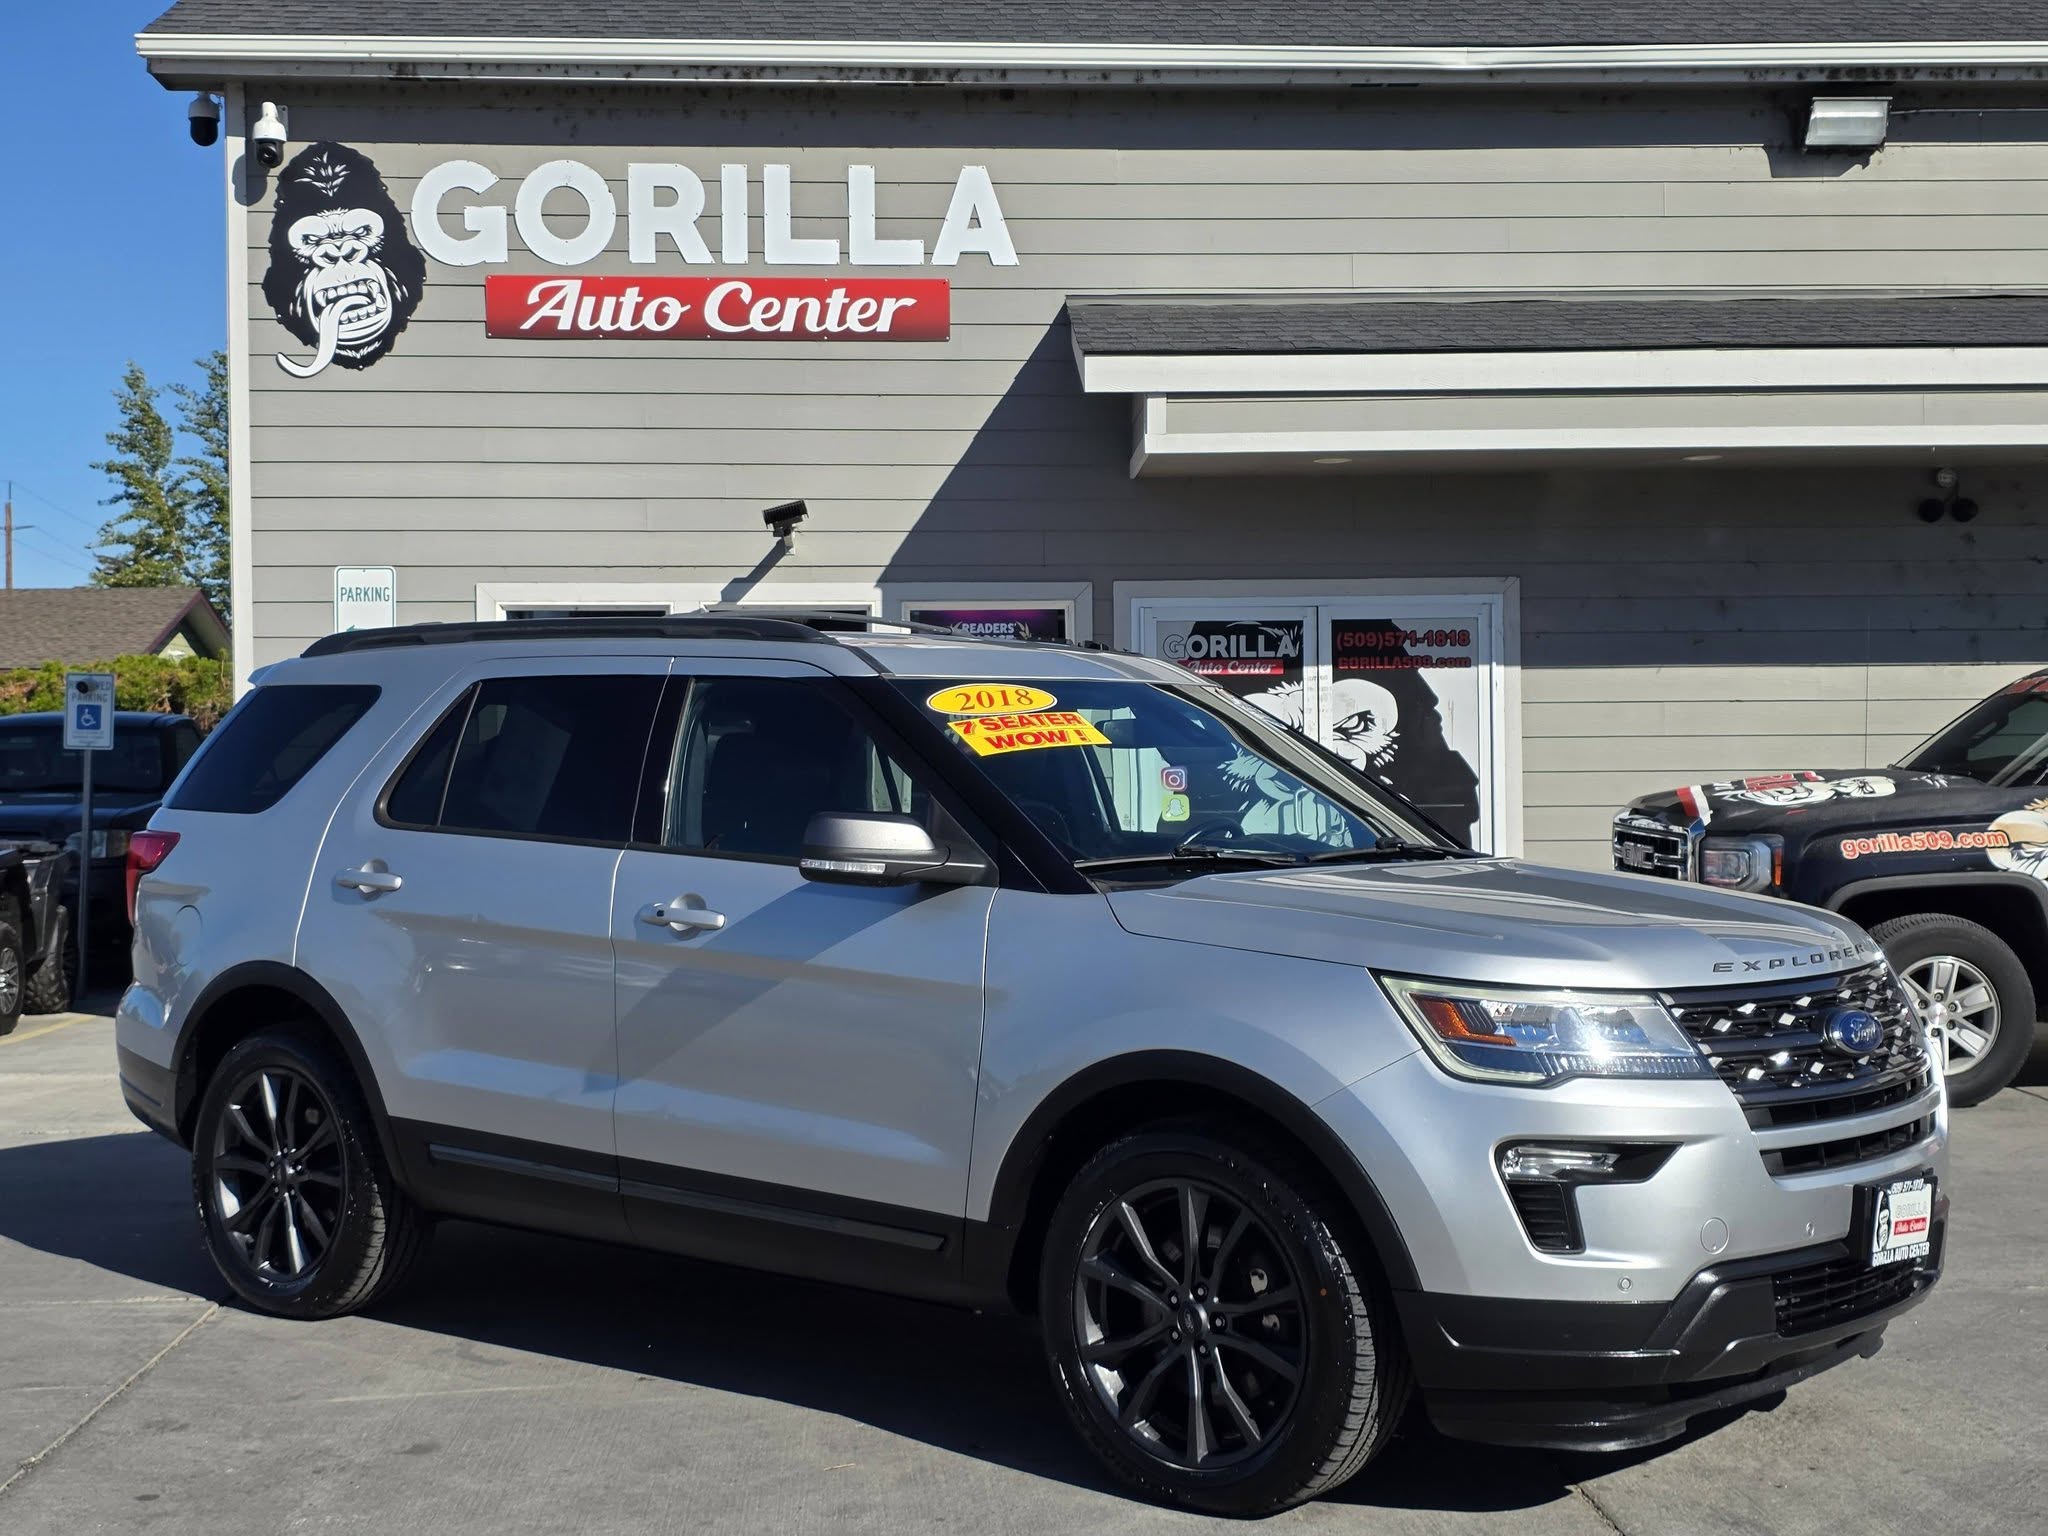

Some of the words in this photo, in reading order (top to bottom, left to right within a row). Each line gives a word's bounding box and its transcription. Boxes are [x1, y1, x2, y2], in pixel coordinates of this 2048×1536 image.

[410, 159, 1020, 266] GORILLA
[520, 279, 691, 332] Auto
[703, 280, 917, 334] Center
[340, 586, 390, 602] PARKING
[960, 622, 1017, 634] READERS'
[1163, 634, 1297, 659] GORILLA
[1337, 629, 1471, 650] (509)571-1818
[1187, 660, 1223, 674] Auto
[1227, 660, 1276, 674] Center
[1338, 655, 1472, 669] GORILLA509.com
[955, 689, 1034, 711] 2018
[954, 721, 976, 735] 7
[979, 713, 1086, 732] SEATER
[984, 729, 1069, 750] WOW
[1622, 841, 1655, 869] GMC
[1841, 830, 2010, 859] gorilla509.com
[1712, 944, 1865, 973] EXPLORER
[1894, 1245, 1909, 1262] AUTO
[1908, 1241, 1930, 1258] CENTER
